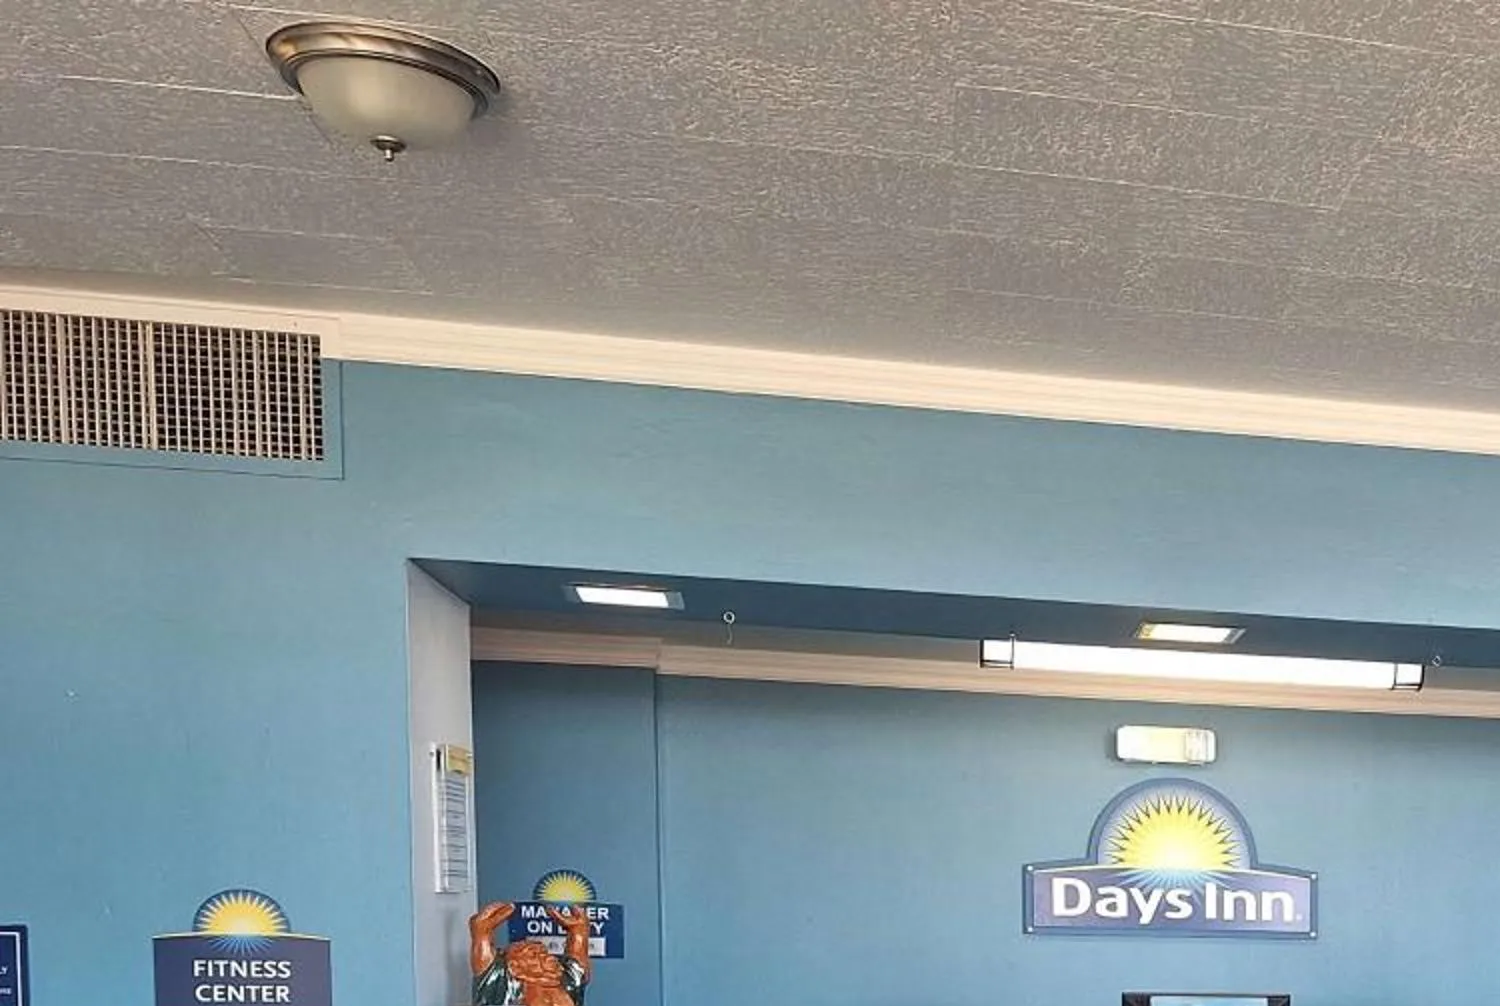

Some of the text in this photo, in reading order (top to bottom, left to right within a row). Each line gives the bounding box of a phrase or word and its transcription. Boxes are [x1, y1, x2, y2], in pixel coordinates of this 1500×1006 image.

[1051, 876, 1294, 925] Days Inn
[521, 905, 609, 920] MAAER
[527, 920, 552, 934] ON
[193, 959, 292, 979] FITNESS
[195, 984, 291, 1003] CENTER
